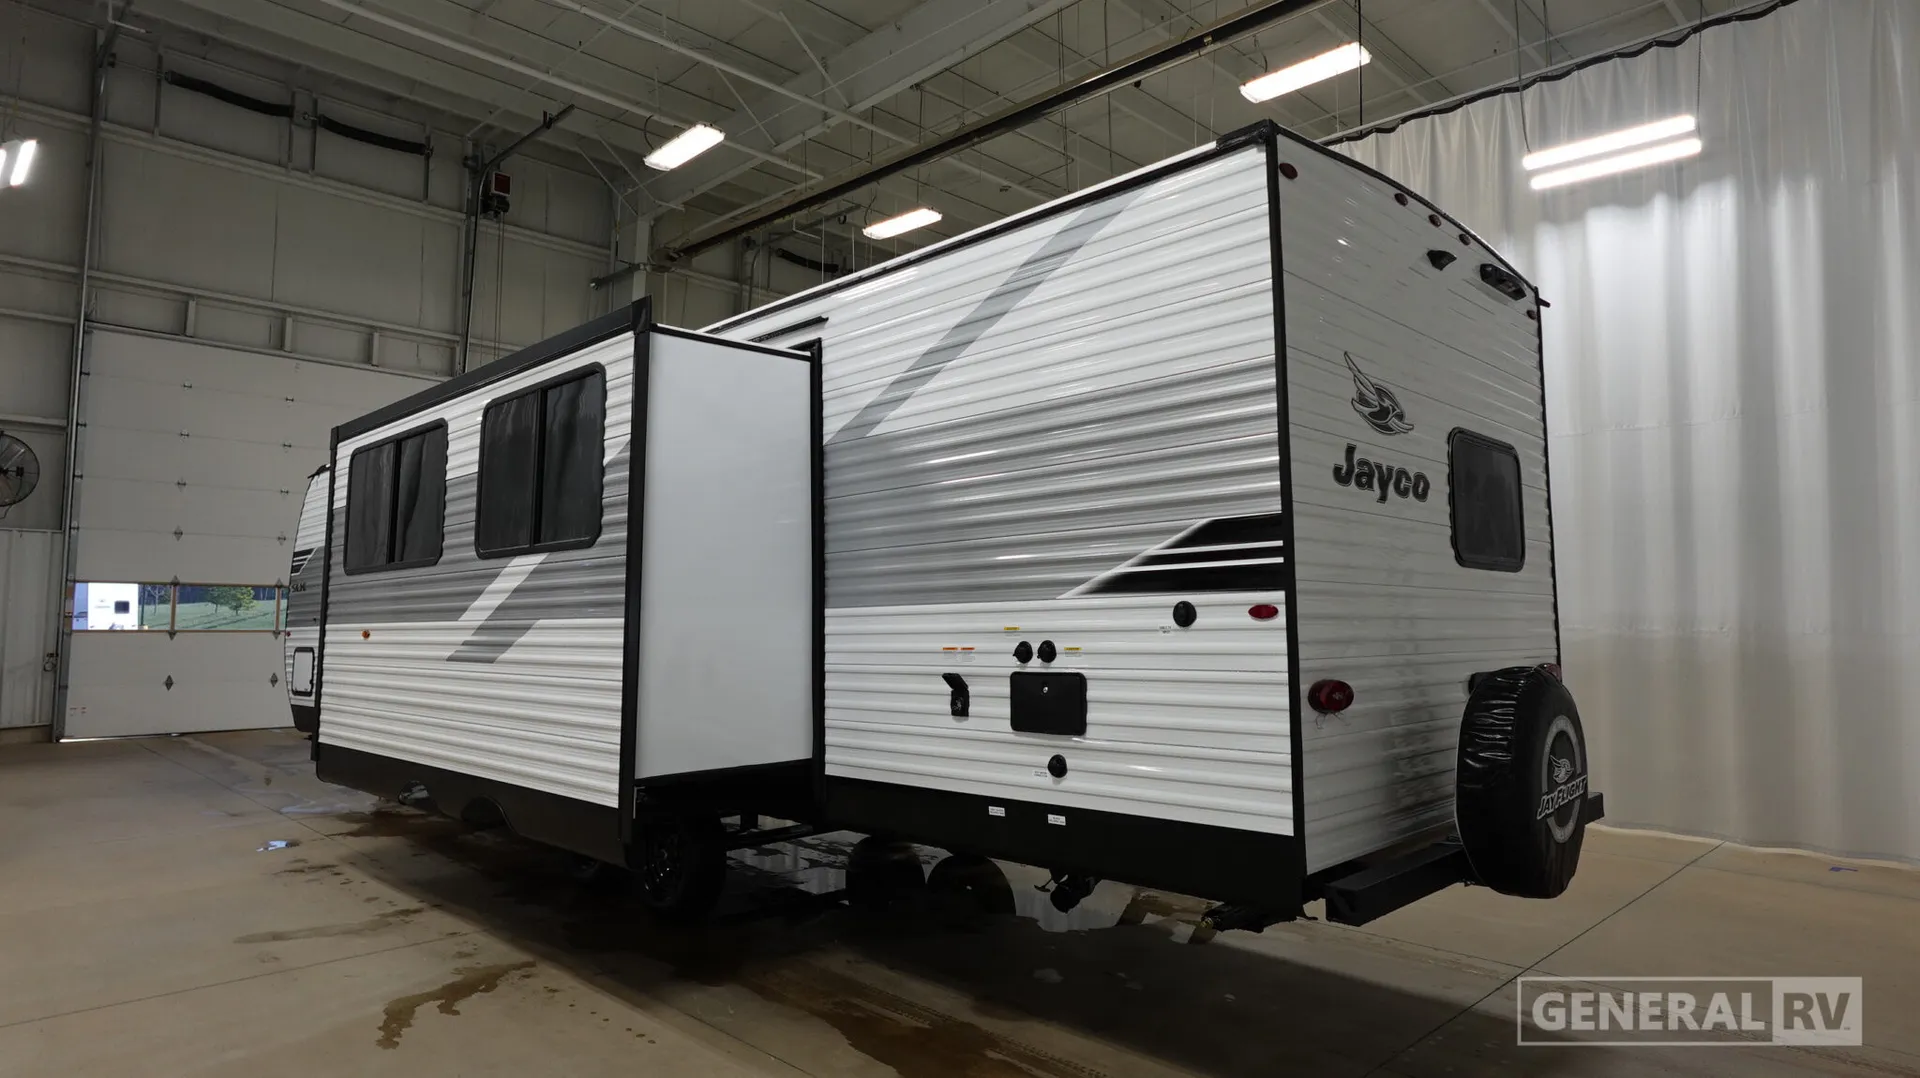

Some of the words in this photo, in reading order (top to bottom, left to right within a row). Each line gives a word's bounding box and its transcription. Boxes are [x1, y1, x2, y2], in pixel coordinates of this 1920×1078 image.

[1333, 443, 1431, 504] Jayco
[1537, 794, 1557, 820] JAY
[1555, 776, 1587, 807] FLIGHT
